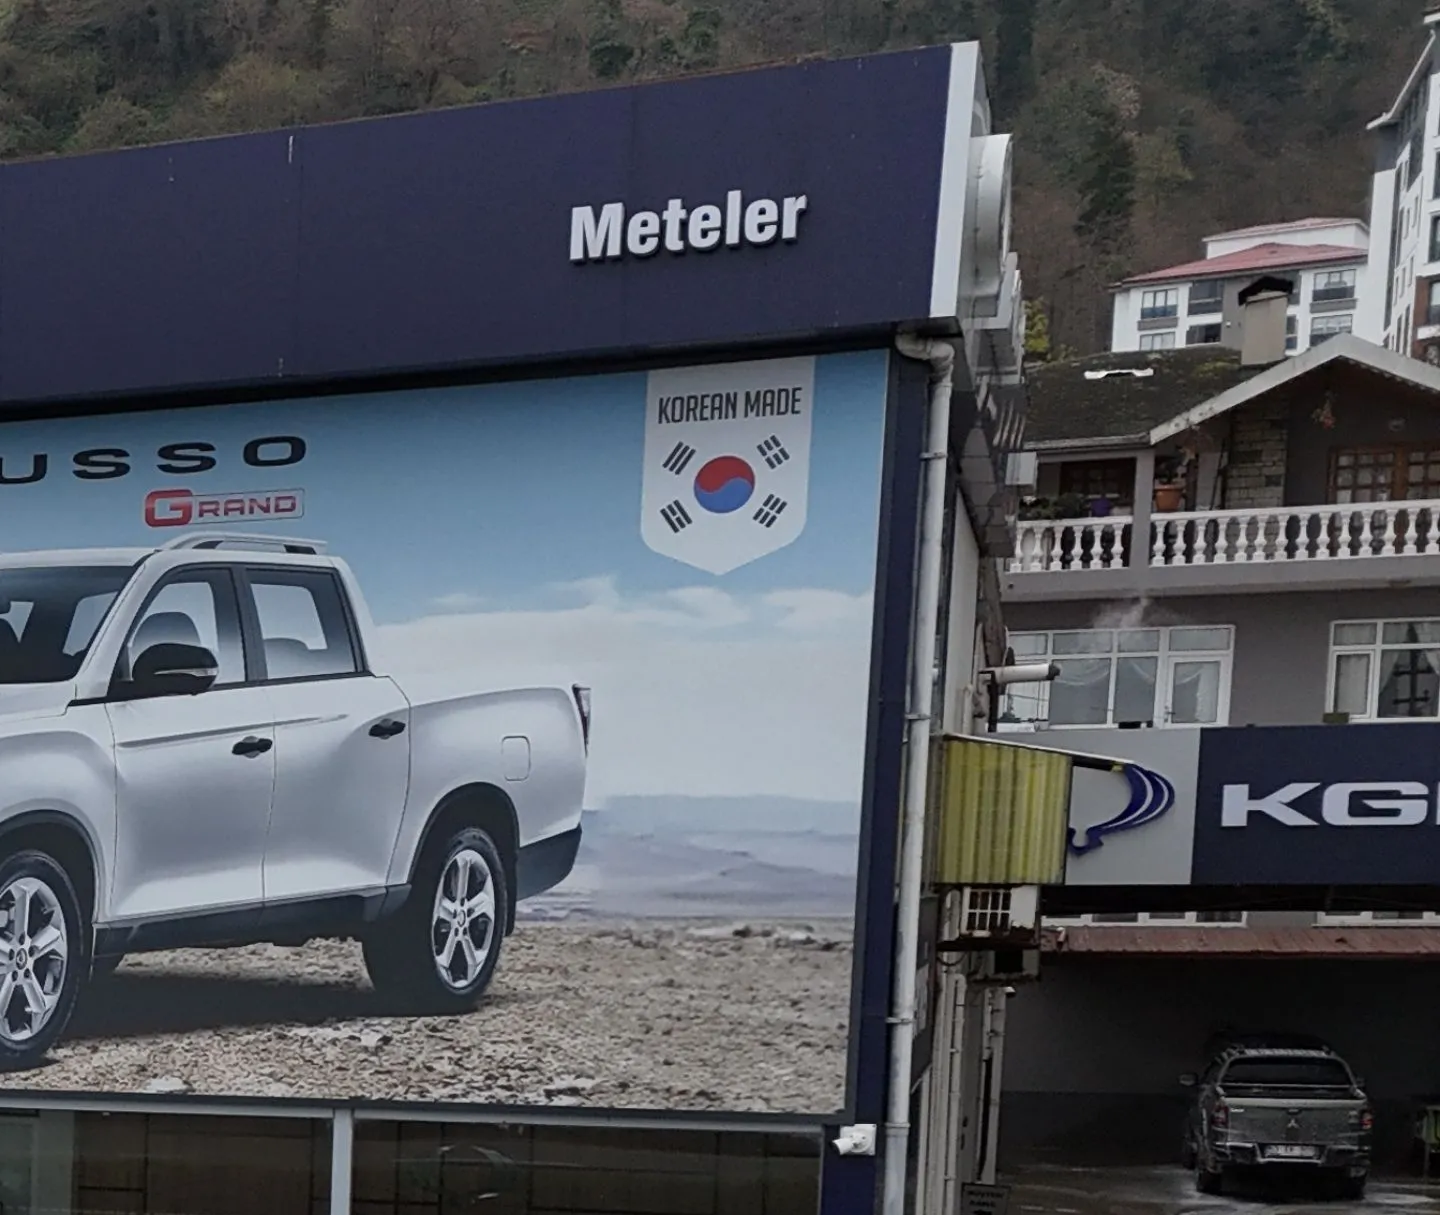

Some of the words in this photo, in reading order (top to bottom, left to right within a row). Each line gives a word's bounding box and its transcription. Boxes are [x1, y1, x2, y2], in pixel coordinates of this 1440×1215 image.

[569, 189, 808, 262] Meteler
[658, 391, 737, 424] KOREAN
[744, 387, 802, 418] MADE
[1221, 781, 1440, 827] KG
